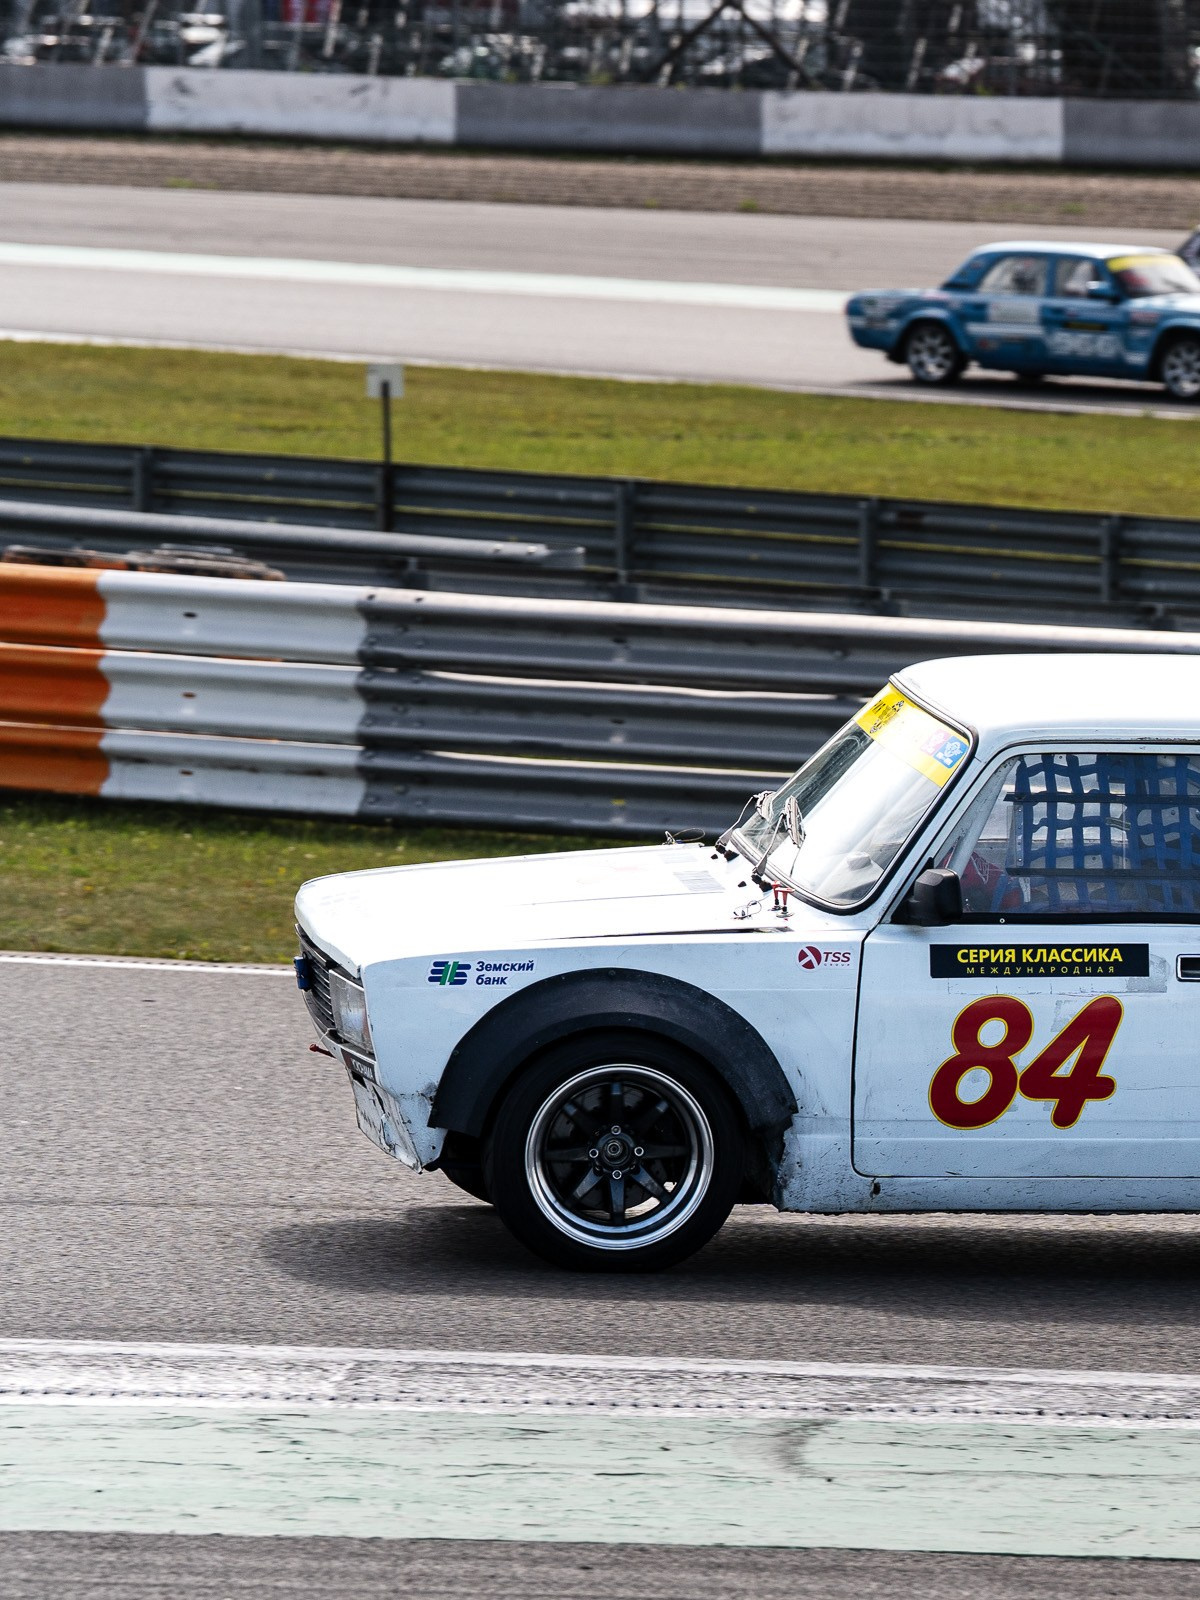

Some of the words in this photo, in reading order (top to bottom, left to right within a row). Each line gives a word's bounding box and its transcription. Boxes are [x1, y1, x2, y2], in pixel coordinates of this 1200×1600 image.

[823, 951, 851, 963] TSS
[956, 949, 1017, 963] СЕРИЯ
[1021, 948, 1124, 963] КЛАССИКА
[475, 960, 534, 972] Земский
[966, 966, 1115, 975] МЕЖДУНАРОДНАЯ
[475, 974, 508, 986] банк
[928, 994, 1124, 1130] 84
